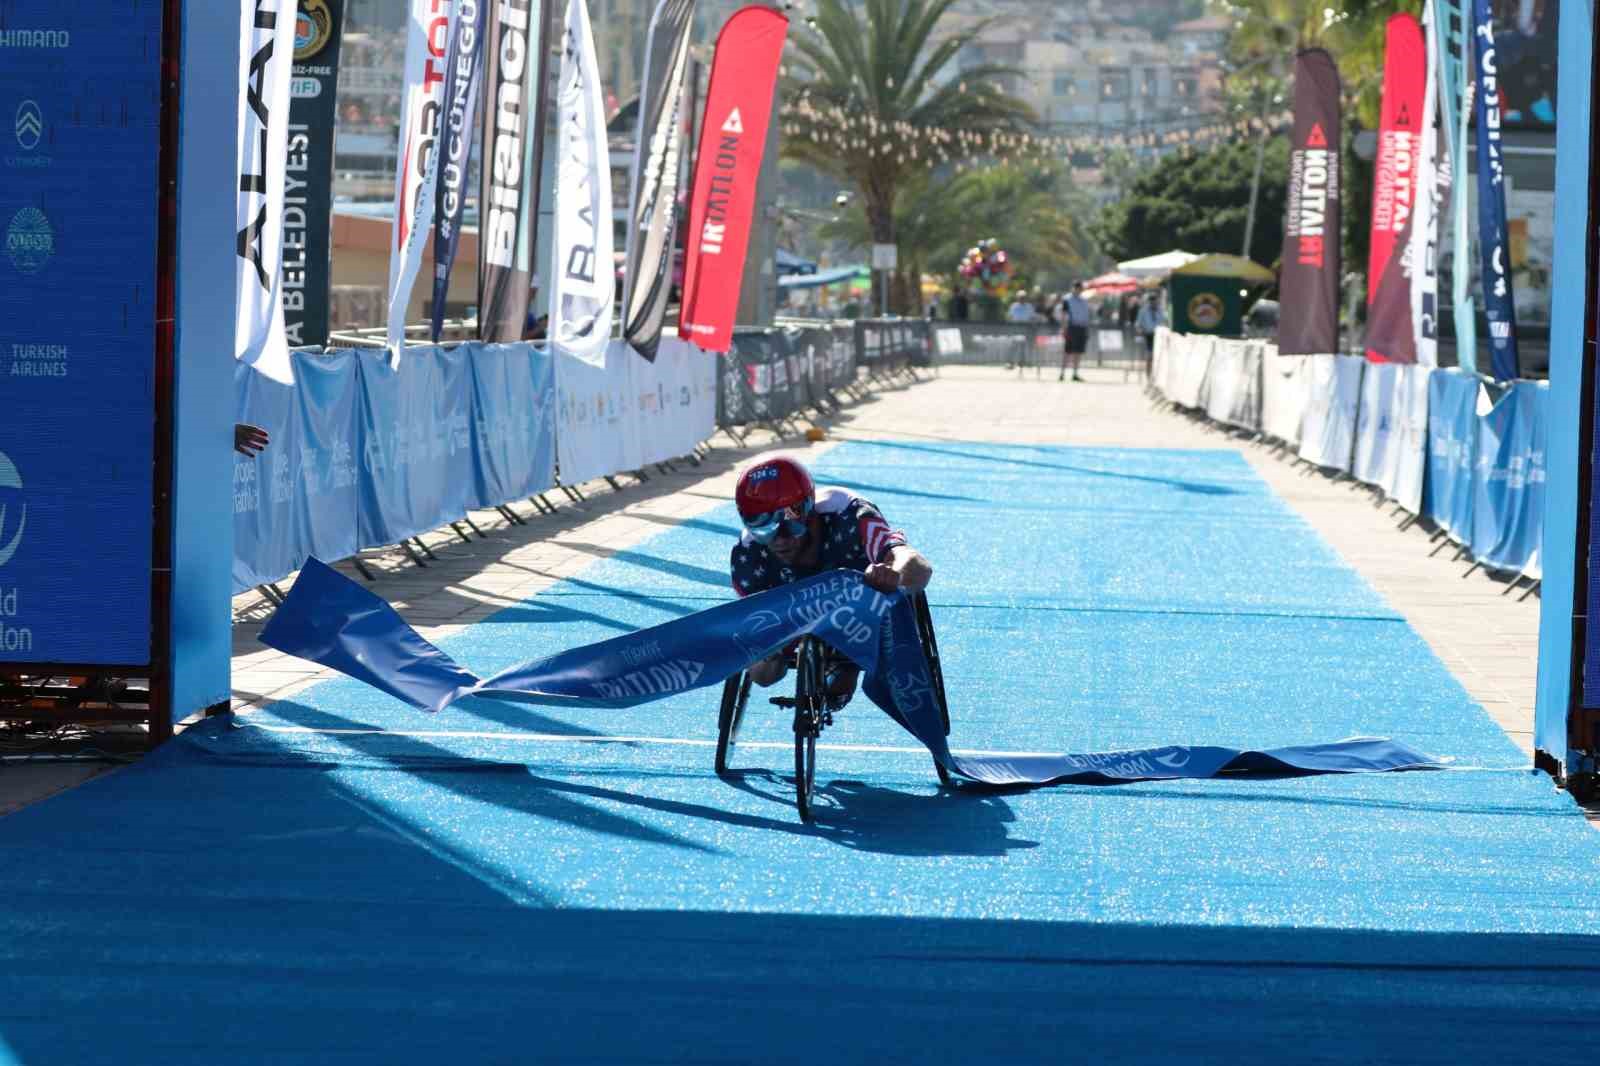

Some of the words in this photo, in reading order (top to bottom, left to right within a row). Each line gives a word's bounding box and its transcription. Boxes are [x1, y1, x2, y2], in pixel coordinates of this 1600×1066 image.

[11, 344, 67, 359] TURKISH
[10, 361, 67, 377] AIRLINES
[830, 605, 874, 645] Cup
